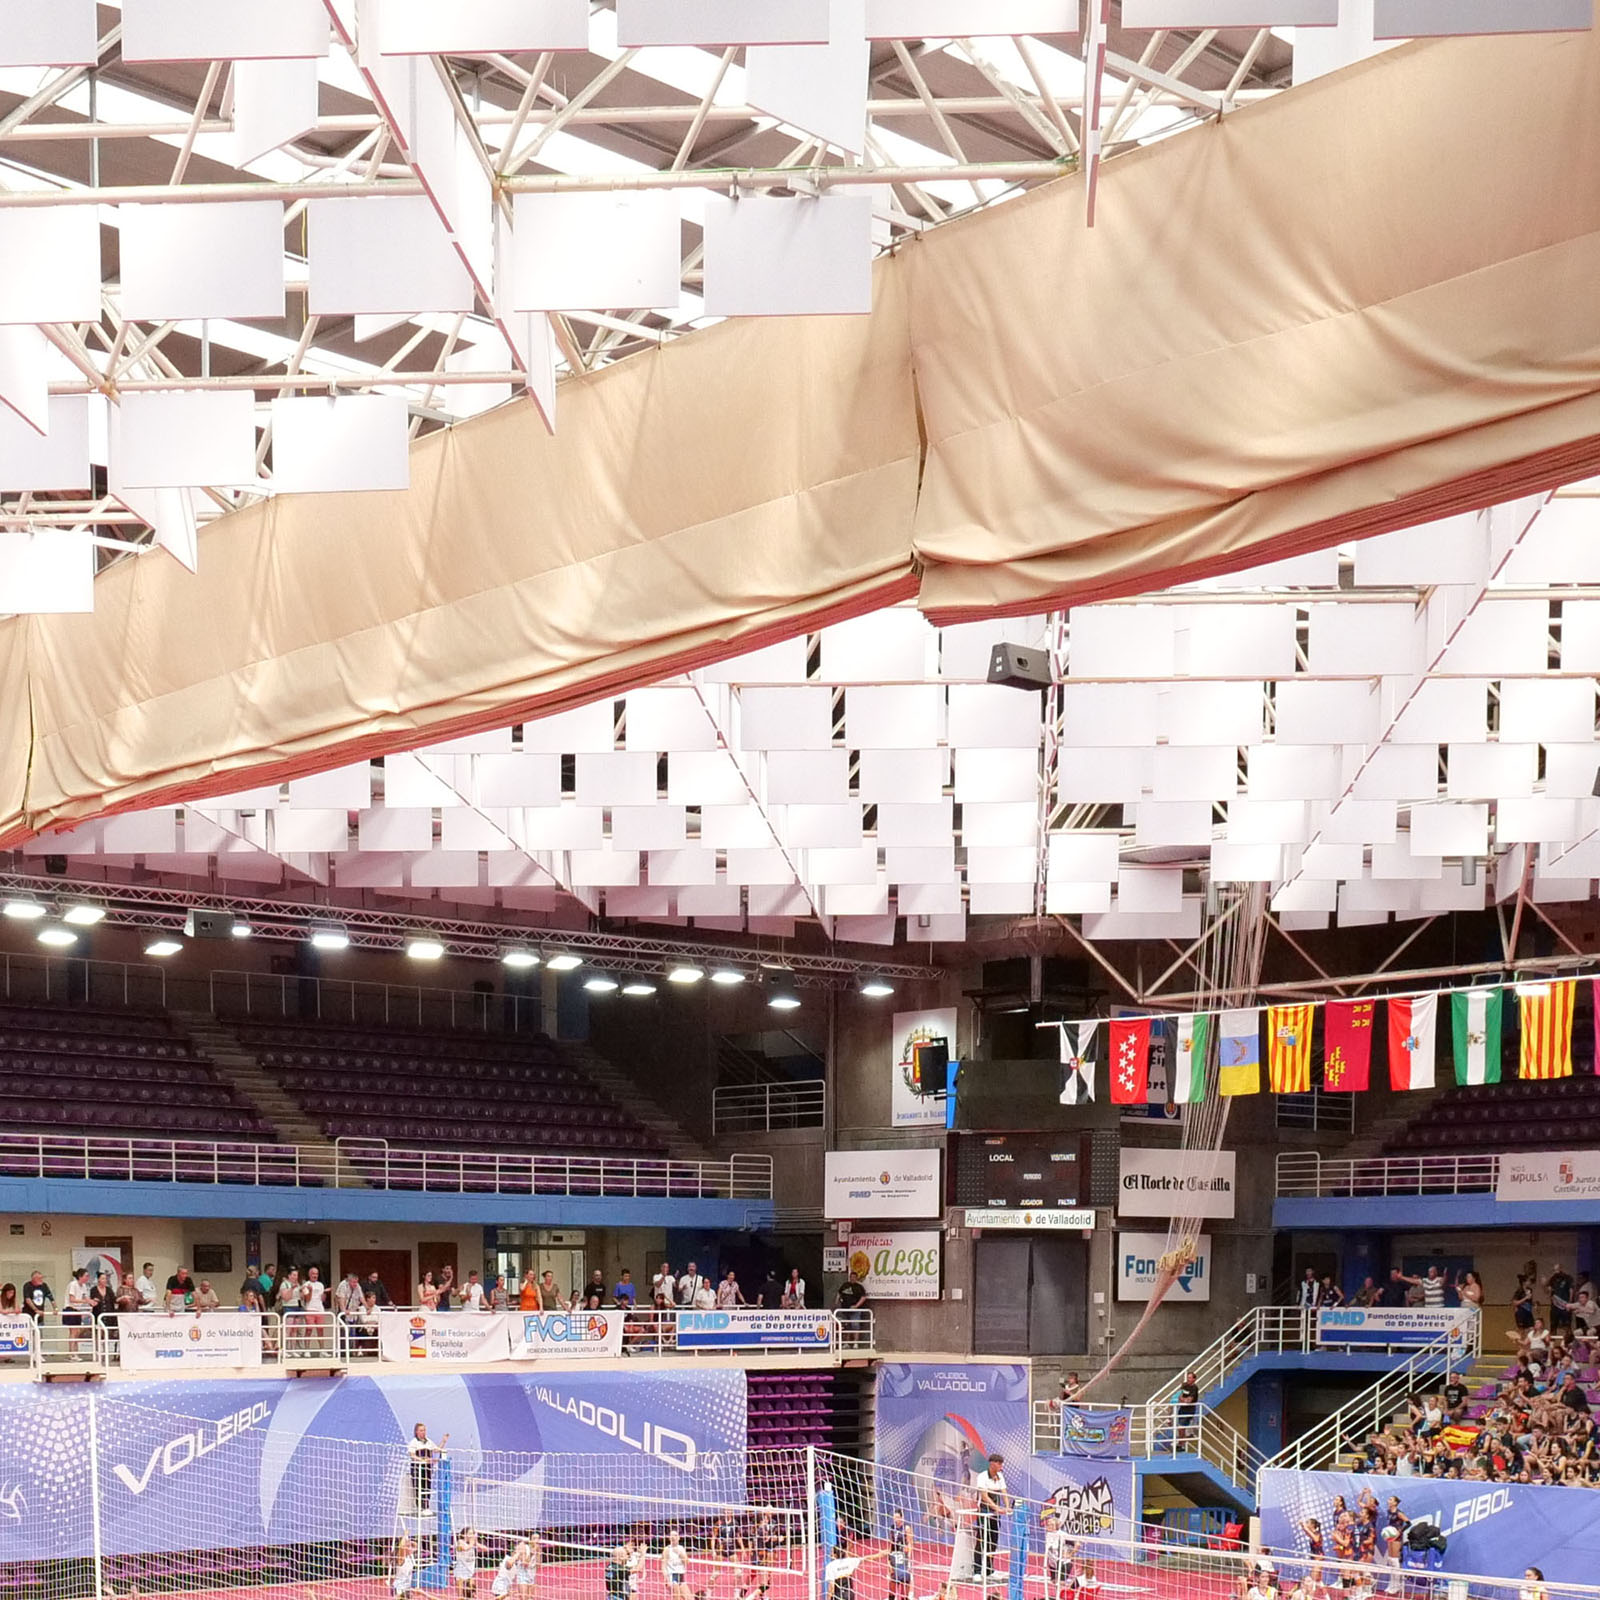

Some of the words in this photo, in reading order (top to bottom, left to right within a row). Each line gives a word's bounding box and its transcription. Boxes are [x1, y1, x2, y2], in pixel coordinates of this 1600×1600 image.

[989, 1154, 1014, 1162] LOCAL
[1051, 1154, 1076, 1162] VISITANTE
[1123, 1174, 1139, 1190] El
[1140, 1174, 1172, 1191] Norte
[1173, 1176, 1185, 1191] de
[1575, 1175, 1596, 1184] Junta
[1554, 1185, 1579, 1193] Castilla
[1581, 1186, 1587, 1194] y
[966, 1213, 1021, 1225] Ayuntamiento
[1036, 1213, 1046, 1224] de
[1049, 1213, 1091, 1225] Valladolid
[850, 1235, 893, 1250] Limpiezas
[874, 1249, 938, 1276] ALBE
[679, 1313, 729, 1330] FMD
[731, 1314, 780, 1322] Fundación
[783, 1313, 830, 1322] Municipal
[1321, 1311, 1365, 1326] FMD
[1398, 1320, 1445, 1328] Deportes
[523, 1314, 584, 1343] FVCL
[751, 1322, 762, 1330] de
[766, 1322, 813, 1330] Deportes
[128, 1331, 183, 1340] Ayuntamiento
[207, 1330, 216, 1338] de
[219, 1329, 254, 1338] Valladolid
[432, 1329, 446, 1337] Real
[448, 1329, 486, 1338] Federación
[431, 1340, 463, 1350] Española
[155, 1349, 184, 1358] FMD
[431, 1350, 440, 1358] de
[441, 1350, 468, 1358] Voleibol
[917, 1381, 987, 1392] VALLADOLID
[535, 1386, 696, 1472] VALLADOLID
[113, 1399, 272, 1495] VOLEIBOL
